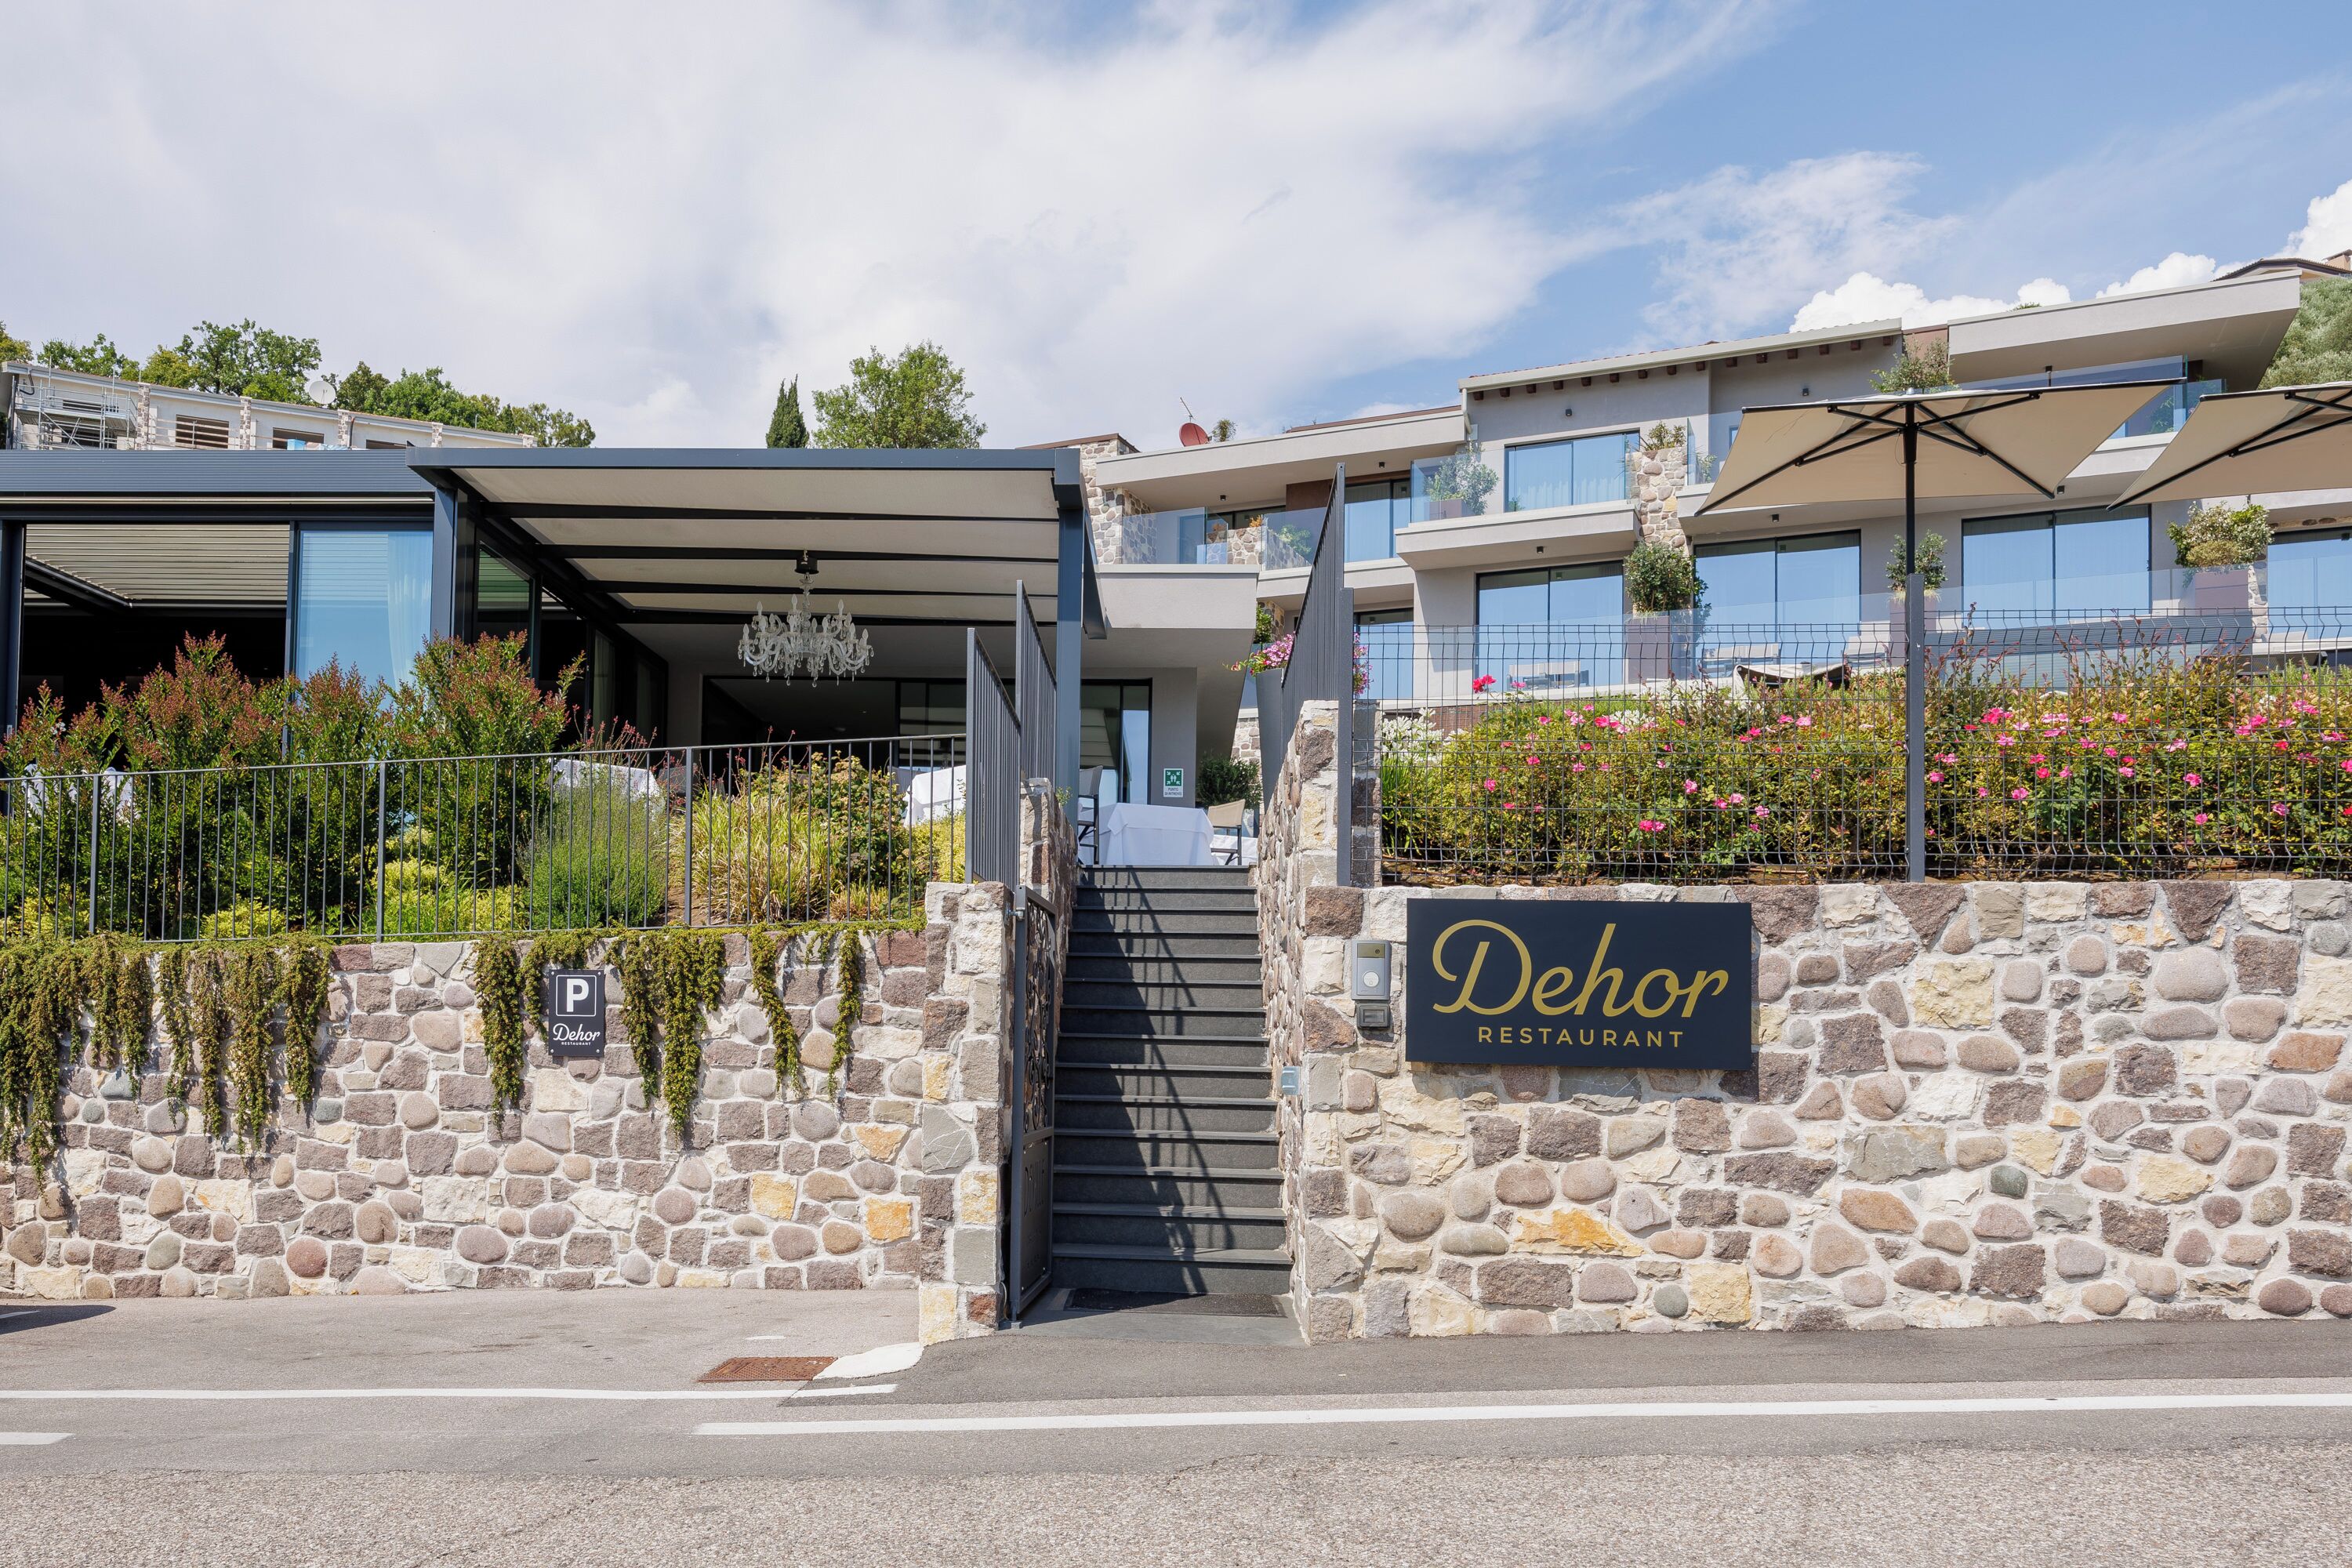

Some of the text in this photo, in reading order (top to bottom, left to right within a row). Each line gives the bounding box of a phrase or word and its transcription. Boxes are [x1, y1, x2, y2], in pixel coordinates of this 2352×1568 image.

[1432, 920, 1729, 1018] Dehor
[566, 978, 590, 1013] P
[552, 1022, 601, 1042] Dehor
[1478, 1026, 1684, 1048] RESTAURANT
